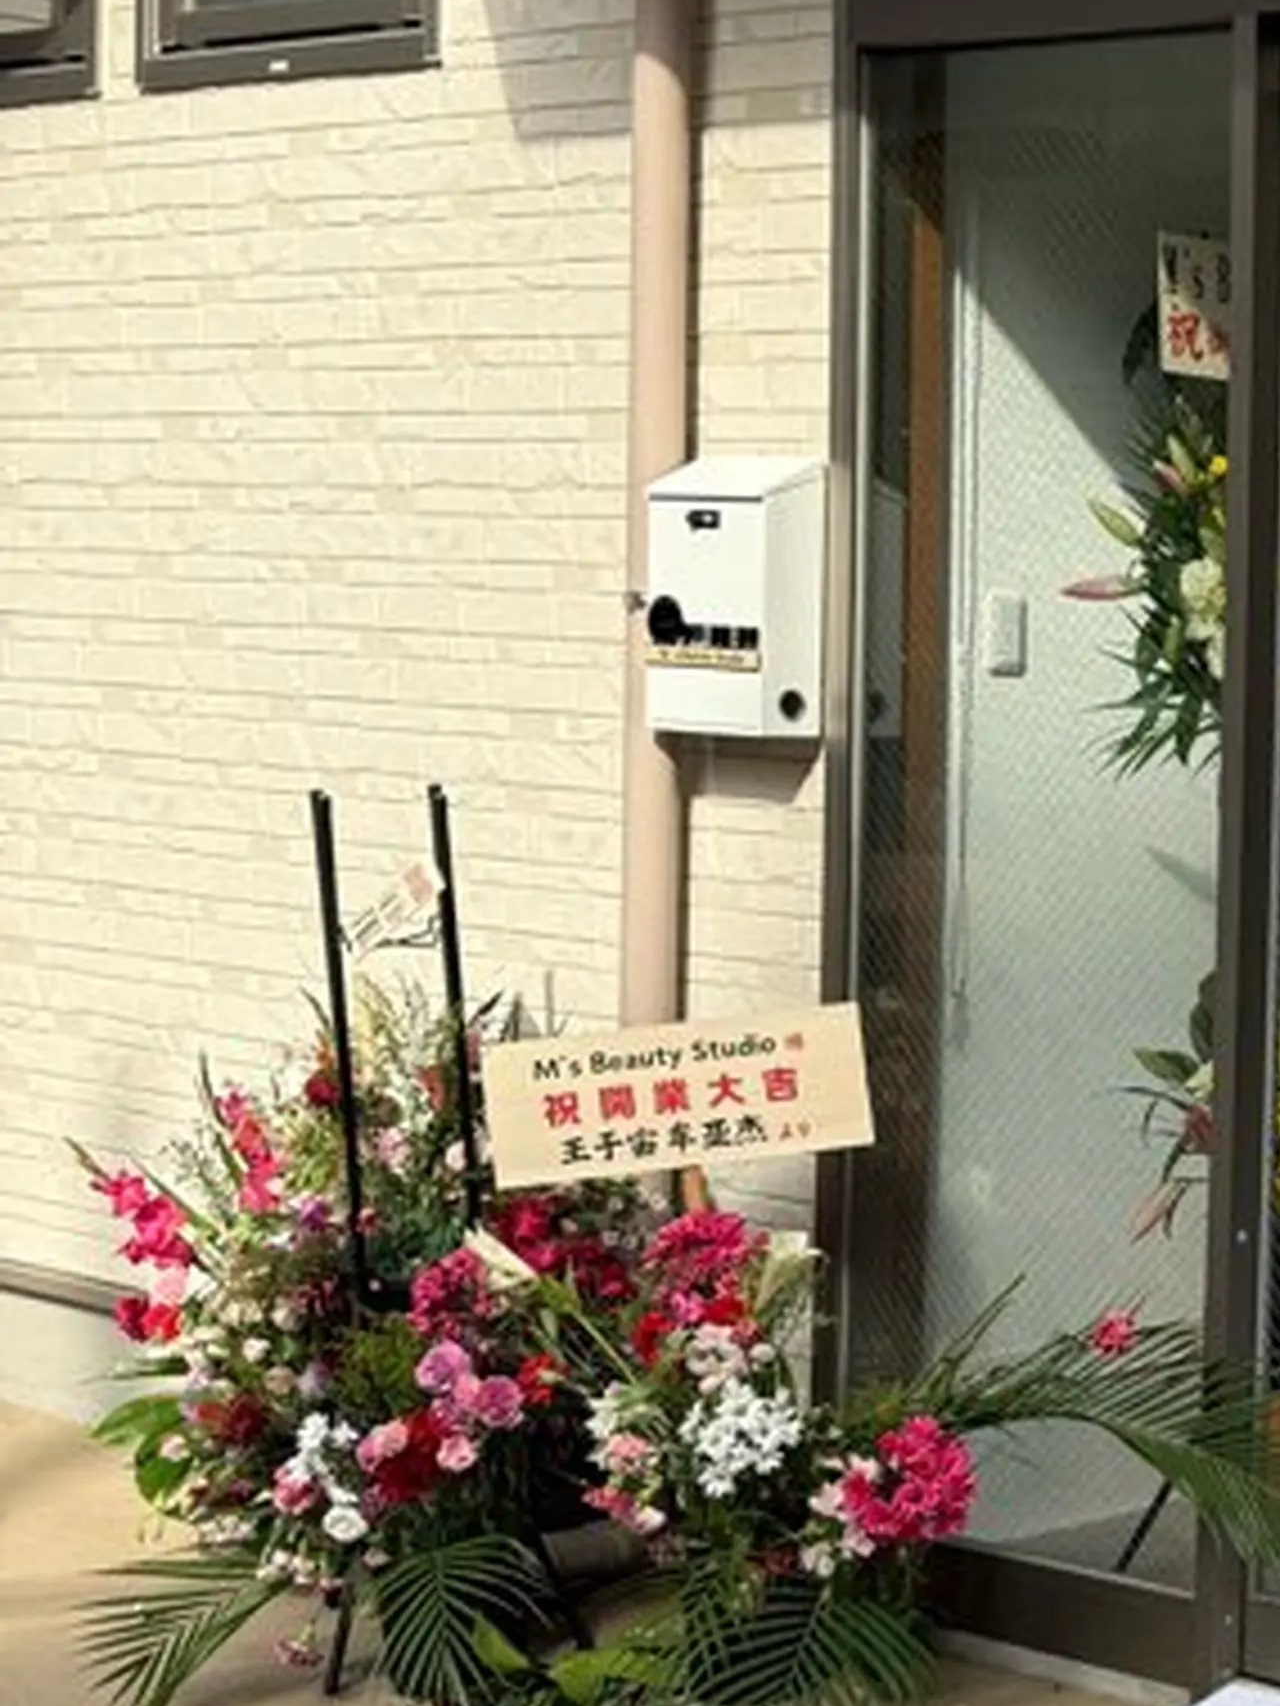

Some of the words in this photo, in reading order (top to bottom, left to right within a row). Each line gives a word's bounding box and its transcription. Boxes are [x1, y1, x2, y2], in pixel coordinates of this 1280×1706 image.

[533, 1056, 583, 1081] M's
[588, 1046, 683, 1077] Beauty
[692, 1034, 777, 1062] Studio
